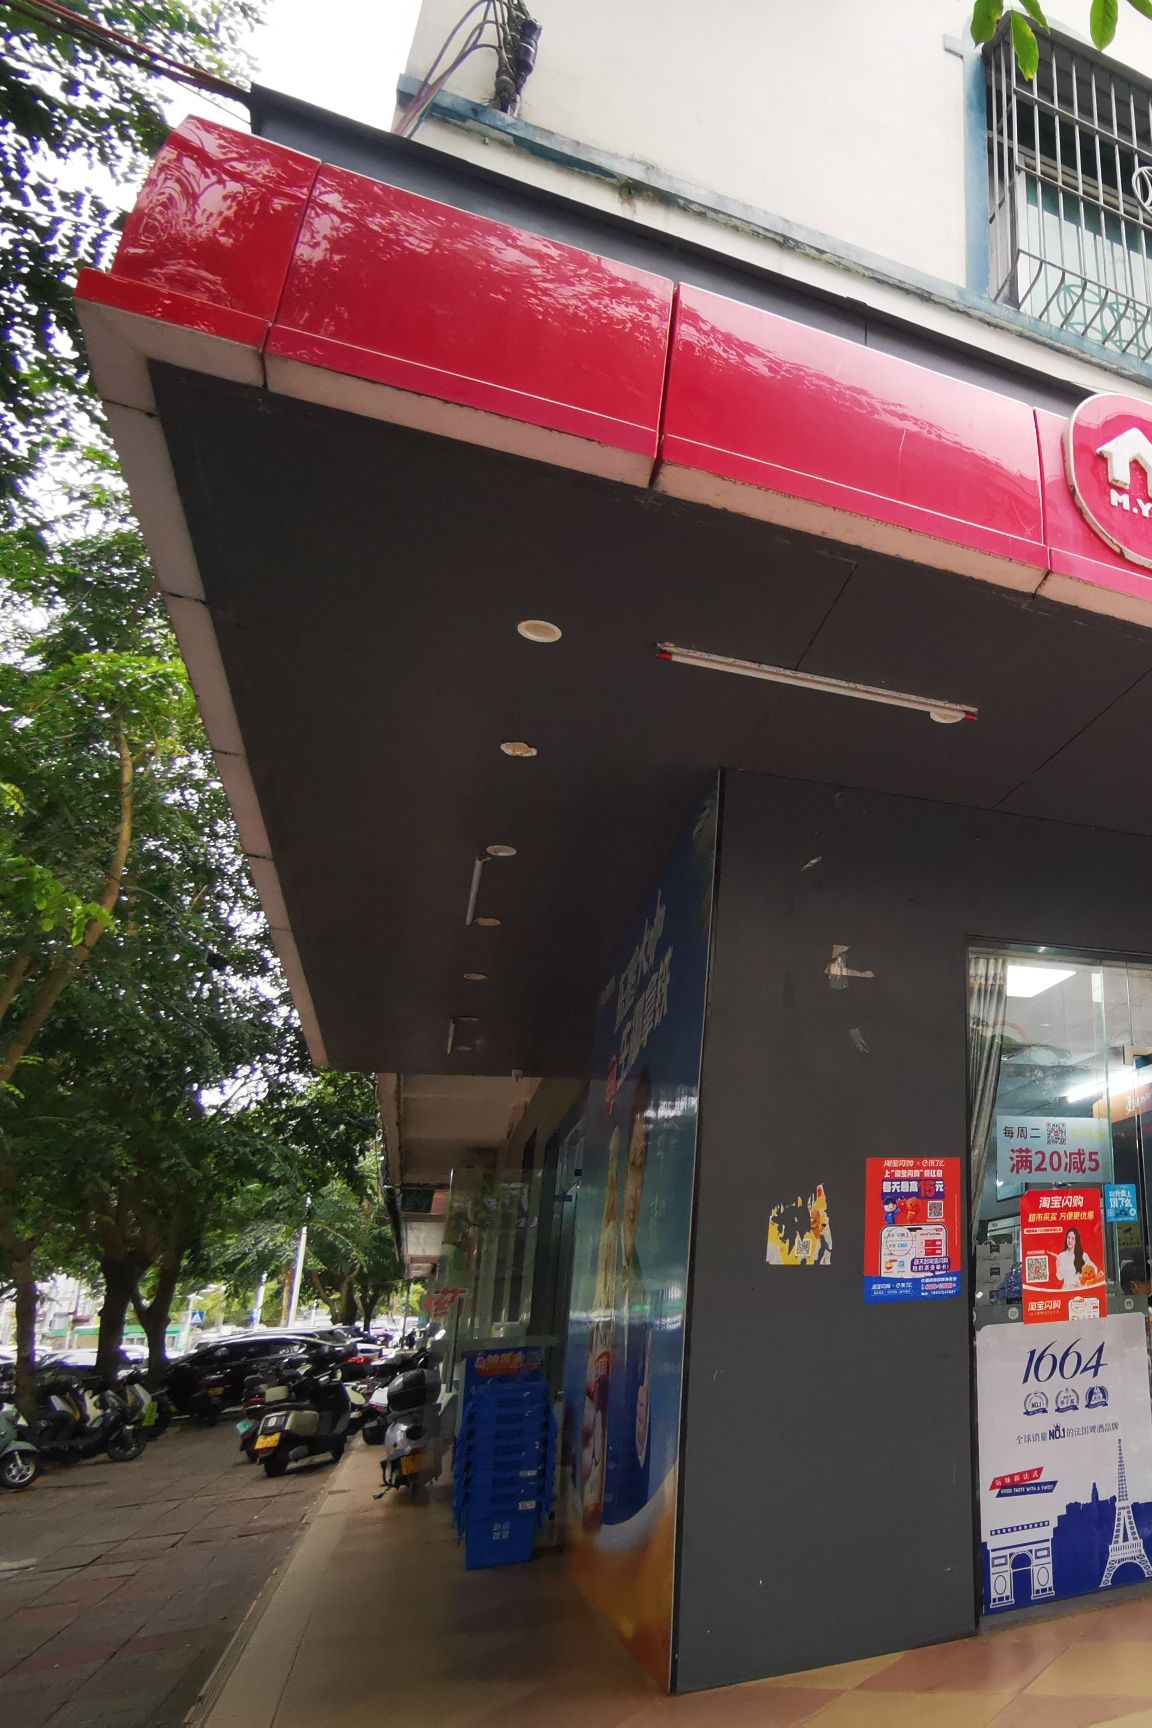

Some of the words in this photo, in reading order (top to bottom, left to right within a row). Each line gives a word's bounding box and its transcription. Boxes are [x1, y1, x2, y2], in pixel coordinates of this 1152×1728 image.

[1002, 1126, 1041, 1140] 每周二
[1009, 1148, 1100, 1175] 满20减5
[1038, 1195, 1084, 1209] 淘宝闪购
[1028, 1300, 1061, 1311] 淘宝闪购
[1022, 1337, 1109, 1384] 1664
